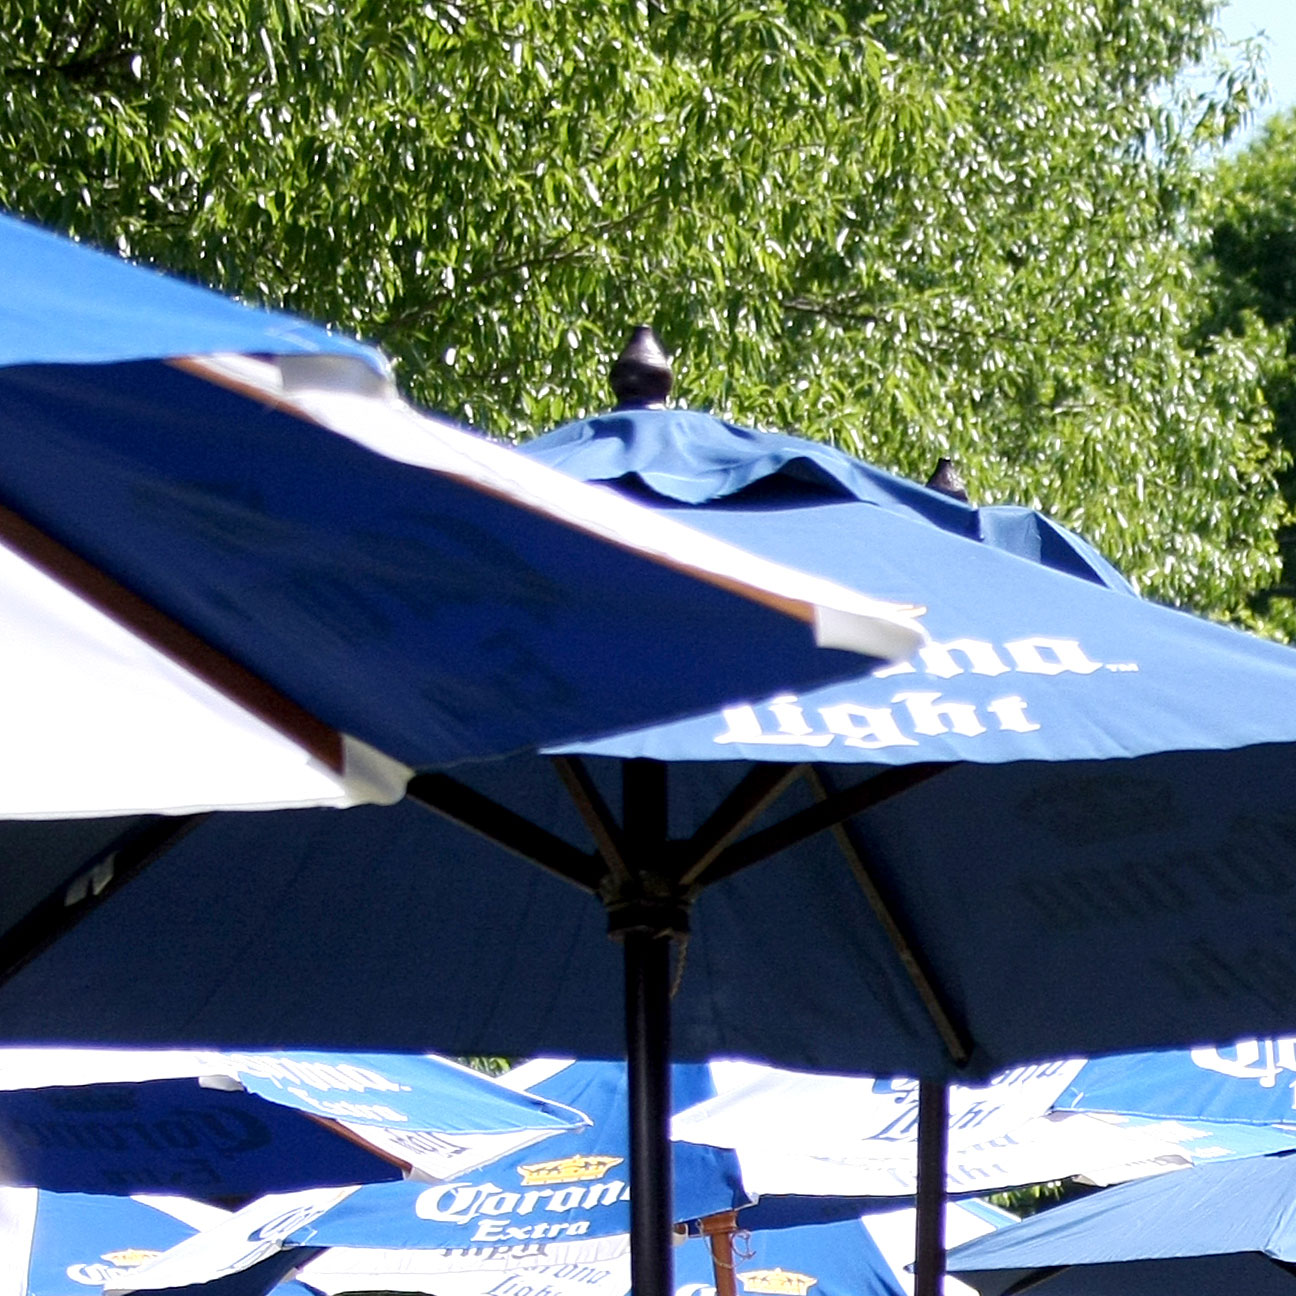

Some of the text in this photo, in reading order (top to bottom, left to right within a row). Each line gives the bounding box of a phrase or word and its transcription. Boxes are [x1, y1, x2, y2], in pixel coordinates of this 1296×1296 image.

[714, 691, 1041, 749] Light
[415, 1179, 631, 1225] Coron
[470, 1218, 591, 1243] Extra
